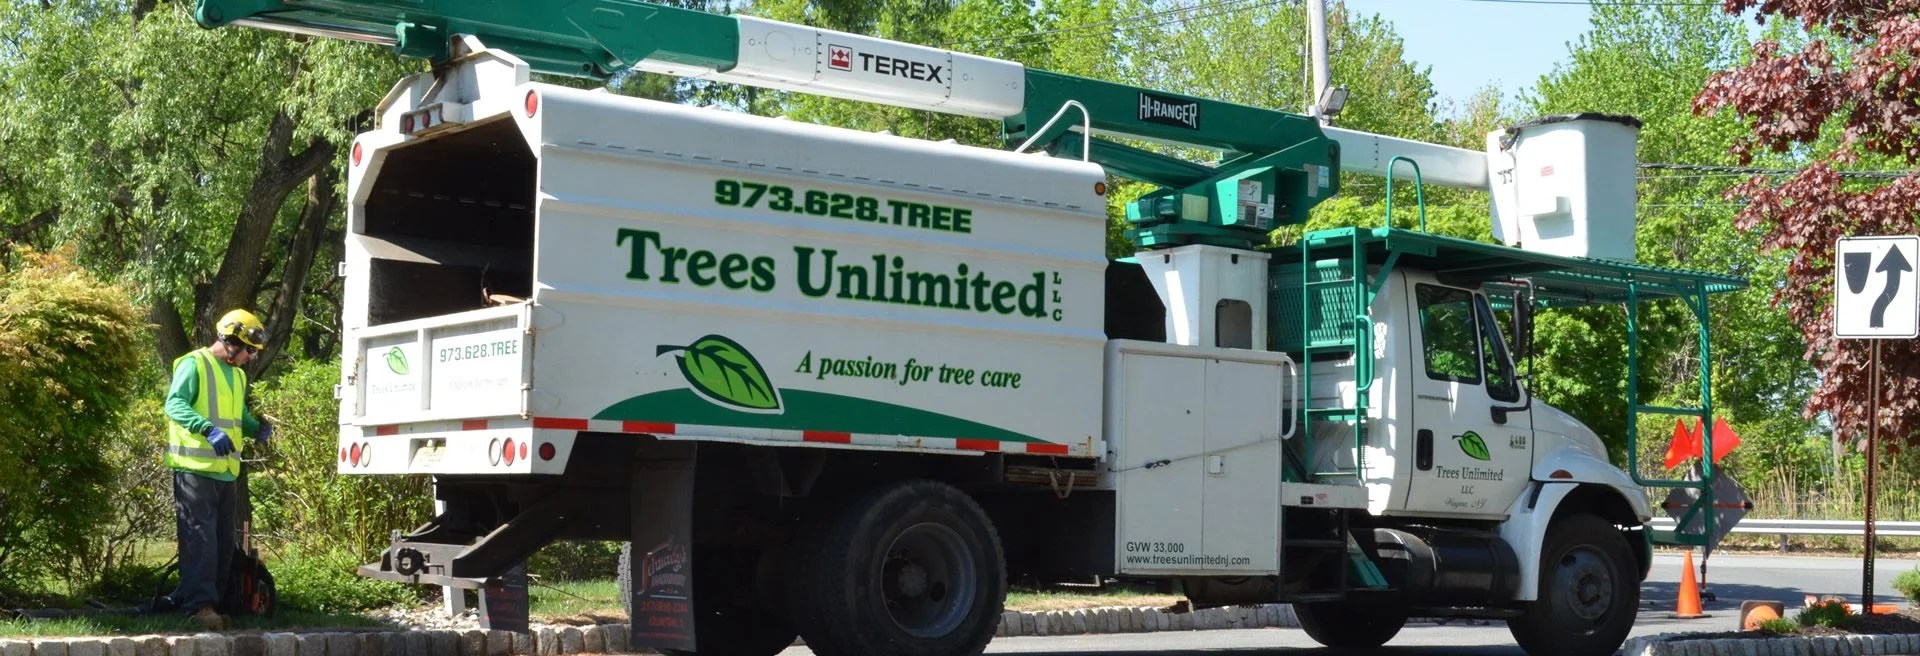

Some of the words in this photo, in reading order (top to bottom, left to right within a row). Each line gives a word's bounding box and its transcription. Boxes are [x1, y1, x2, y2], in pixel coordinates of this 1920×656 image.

[858, 52, 943, 84] TEREX
[1140, 92, 1197, 128] HI-RANGER
[714, 179, 972, 234] 973.628.TREE
[616, 228, 776, 292] Trees
[793, 246, 1048, 318] Unlimited
[439, 340, 517, 362] 973.628.TREE
[795, 350, 812, 373] A
[816, 356, 897, 380] passion
[900, 358, 933, 385] for
[938, 363, 974, 385] tree
[980, 369, 1021, 389] care
[1436, 465, 1460, 480] Trees
[1462, 467, 1504, 481] Unlimited
[1461, 485, 1475, 495] LLC
[1126, 542, 1151, 553] GVW
[1126, 554, 1250, 567] www.treesunlimitednj.com
